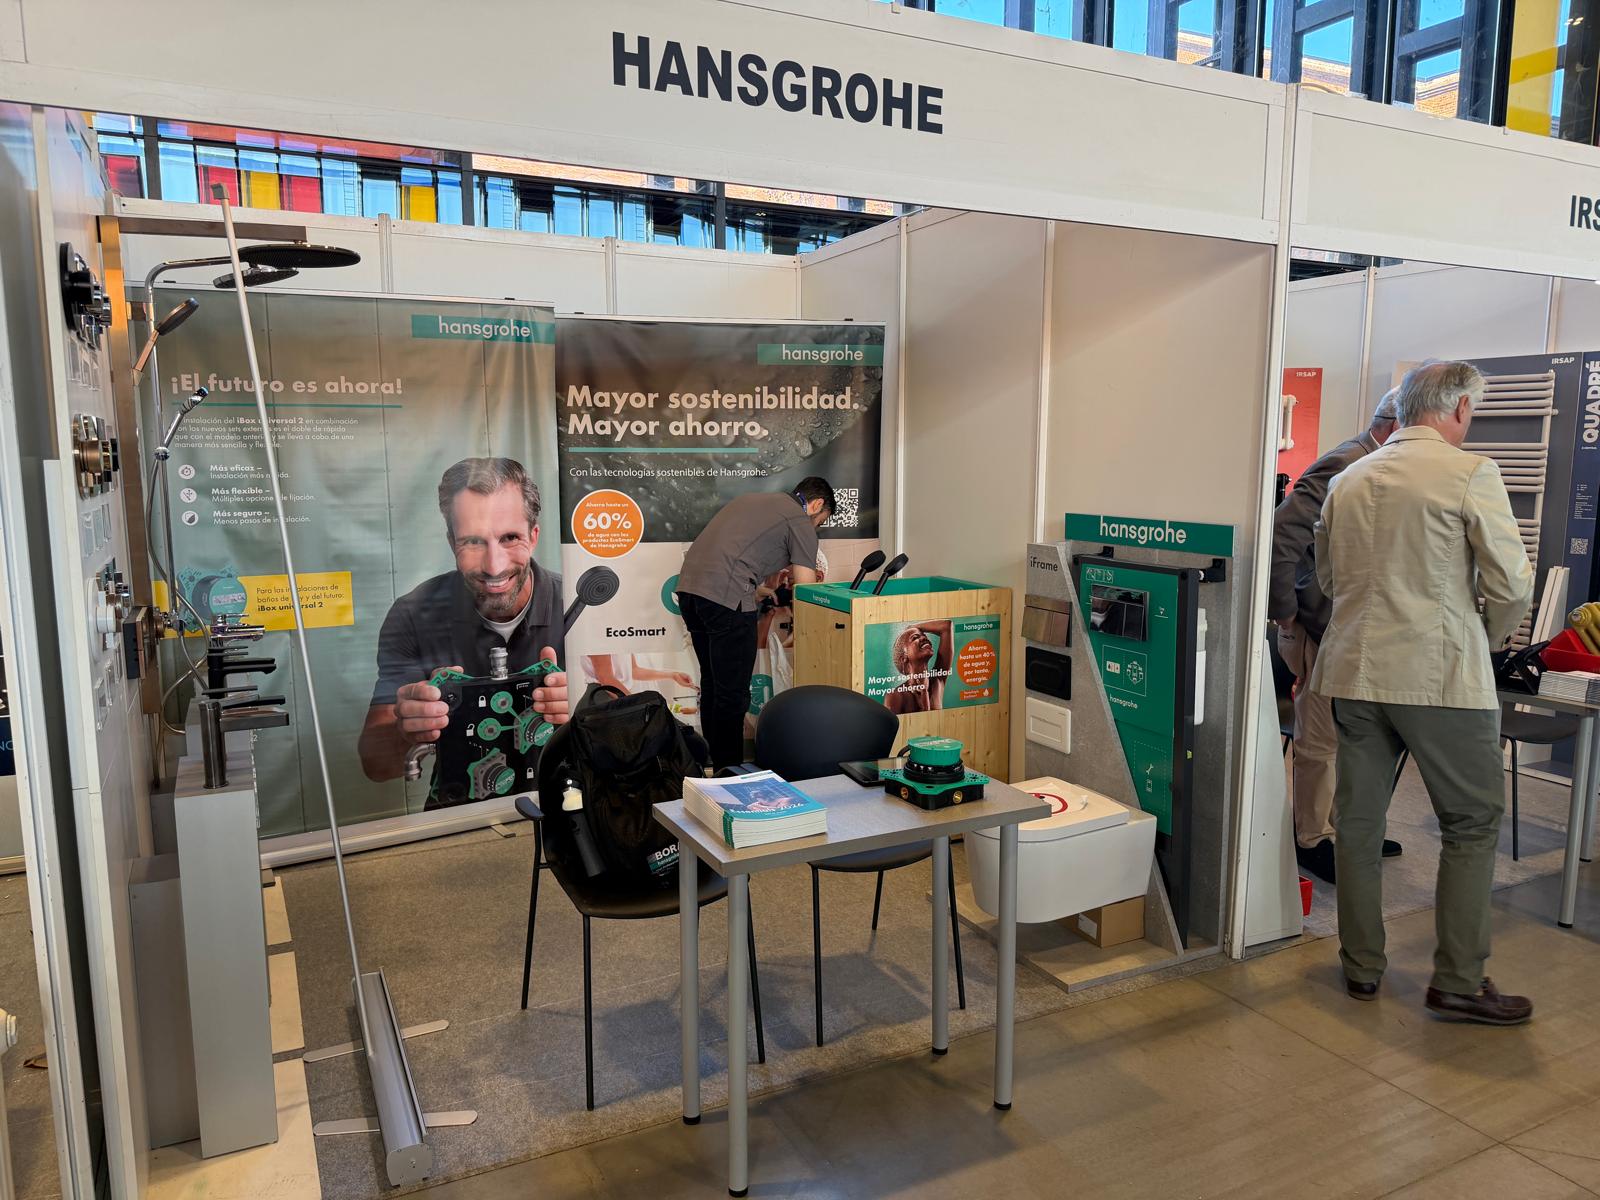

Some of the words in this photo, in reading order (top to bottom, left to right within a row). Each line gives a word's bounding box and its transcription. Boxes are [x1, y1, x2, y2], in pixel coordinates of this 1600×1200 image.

[612, 31, 943, 135] HANSGROHE
[439, 316, 531, 339] hansgrohe
[782, 344, 863, 364] hansgrohe
[171, 373, 200, 394] ¡El
[292, 380, 318, 393] es
[325, 376, 402, 395] ahora!
[567, 385, 659, 414] Mayor
[668, 386, 859, 410] sostenibilidad.
[1582, 360, 1600, 443] QUADRÉ
[568, 413, 660, 442] Mayor
[669, 413, 769, 437] ahorro.
[210, 464, 228, 472] Más
[230, 464, 255, 472] eficaz
[569, 467, 588, 477] Con
[590, 466, 602, 477] las
[604, 466, 655, 480] tecnologías
[656, 466, 705, 477] sostenibles
[706, 467, 719, 477] de
[720, 467, 768, 480] Hansgrohe.
[211, 487, 229, 495] Más
[232, 487, 263, 495] flexible
[212, 495, 244, 503] Múltiples
[213, 517, 239, 525] Menos
[240, 518, 261, 526] pasos
[233, 510, 263, 518] seguro
[583, 512, 632, 530] 60%
[1100, 515, 1187, 544] hansgrohe
[1030, 556, 1059, 572] iFrame
[256, 587, 272, 595] Para
[286, 584, 328, 593] inalaciones
[257, 596, 278, 604] baños
[257, 604, 277, 612] iBox
[279, 602, 316, 610] univrsal
[606, 626, 666, 638] EcoSmart
[963, 622, 993, 631] hansgrohe
[868, 675, 896, 686] Mayor
[897, 667, 953, 682] sostenibilidad
[868, 687, 896, 698] Mayor
[897, 683, 925, 695] ahorro
[1109, 692, 1138, 709] hansgrohe
